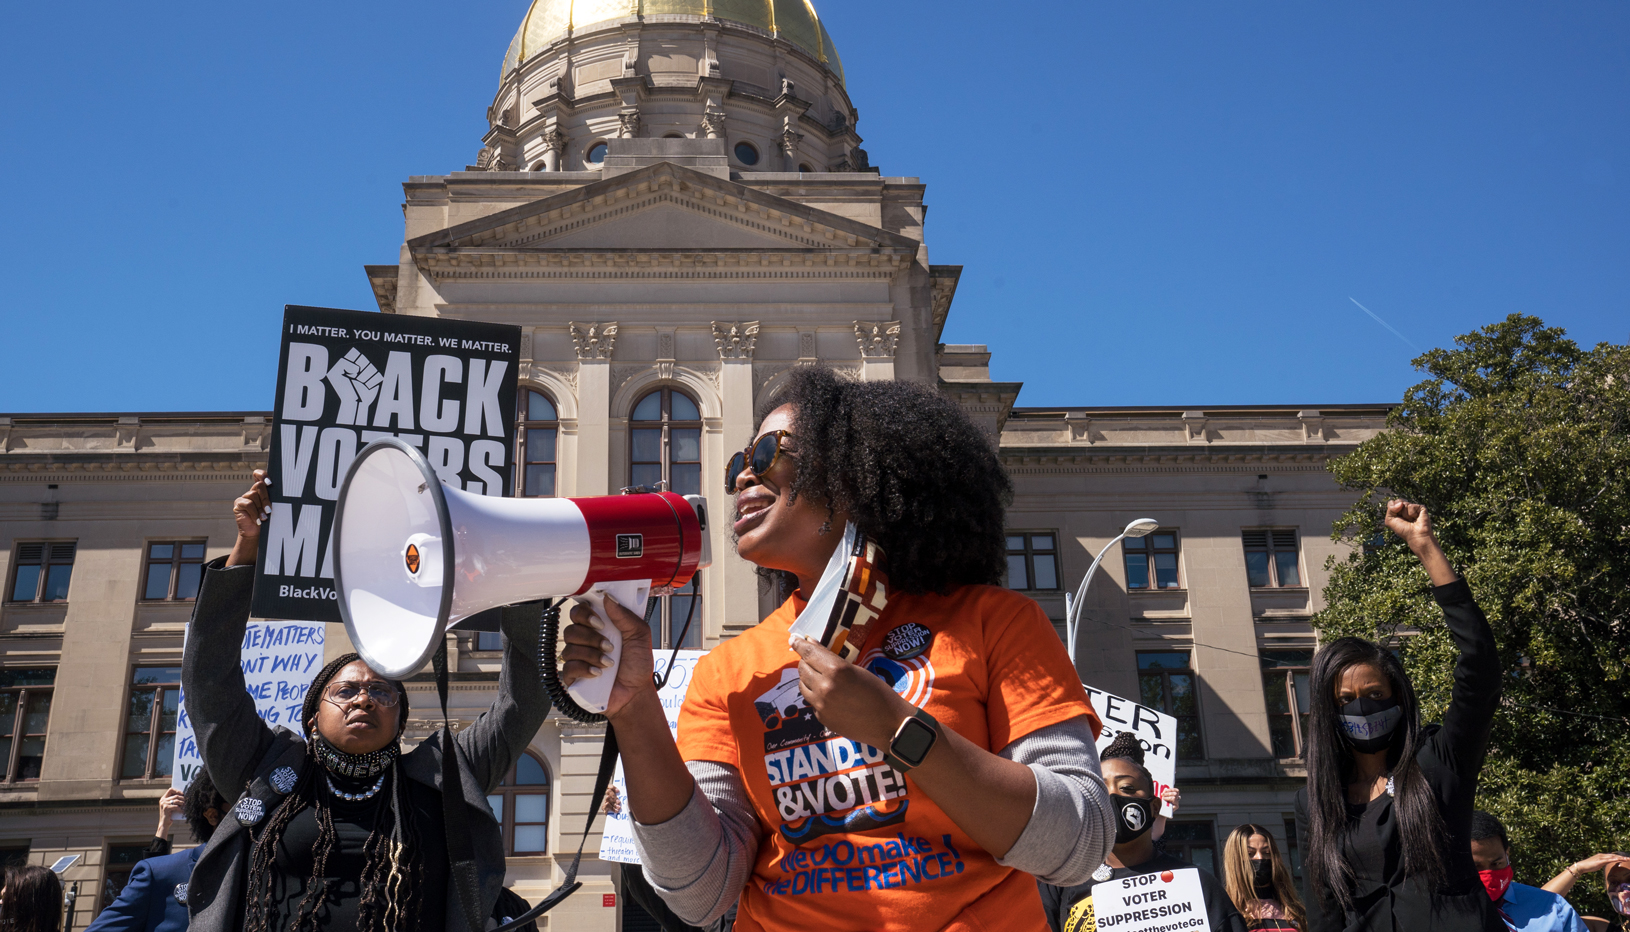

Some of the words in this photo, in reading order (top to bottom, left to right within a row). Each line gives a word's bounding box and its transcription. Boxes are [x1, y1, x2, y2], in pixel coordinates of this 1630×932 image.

[289, 323, 294, 333] I
[297, 324, 350, 339] MATTER.
[353, 329, 380, 341] YOU
[384, 332, 435, 346] MATTER.
[439, 337, 458, 348] WE
[461, 339, 512, 353] MATTER.
[281, 341, 509, 438] BACK
[280, 424, 506, 501] VORS
[887, 627, 922, 644] VOTER
[888, 622, 916, 639] STOP
[894, 636, 925, 655] NOW!
[270, 652, 318, 674] WHY
[274, 680, 313, 702] PEOP
[243, 798, 263, 806] STOP
[238, 812, 258, 822] NOW!
[857, 832, 933, 865] make
[791, 833, 965, 896] DIFFERENCE!
[1122, 874, 1157, 889] STOP
[1122, 890, 1168, 907] VOTER
[1097, 901, 1193, 928] SUPPRESSION
